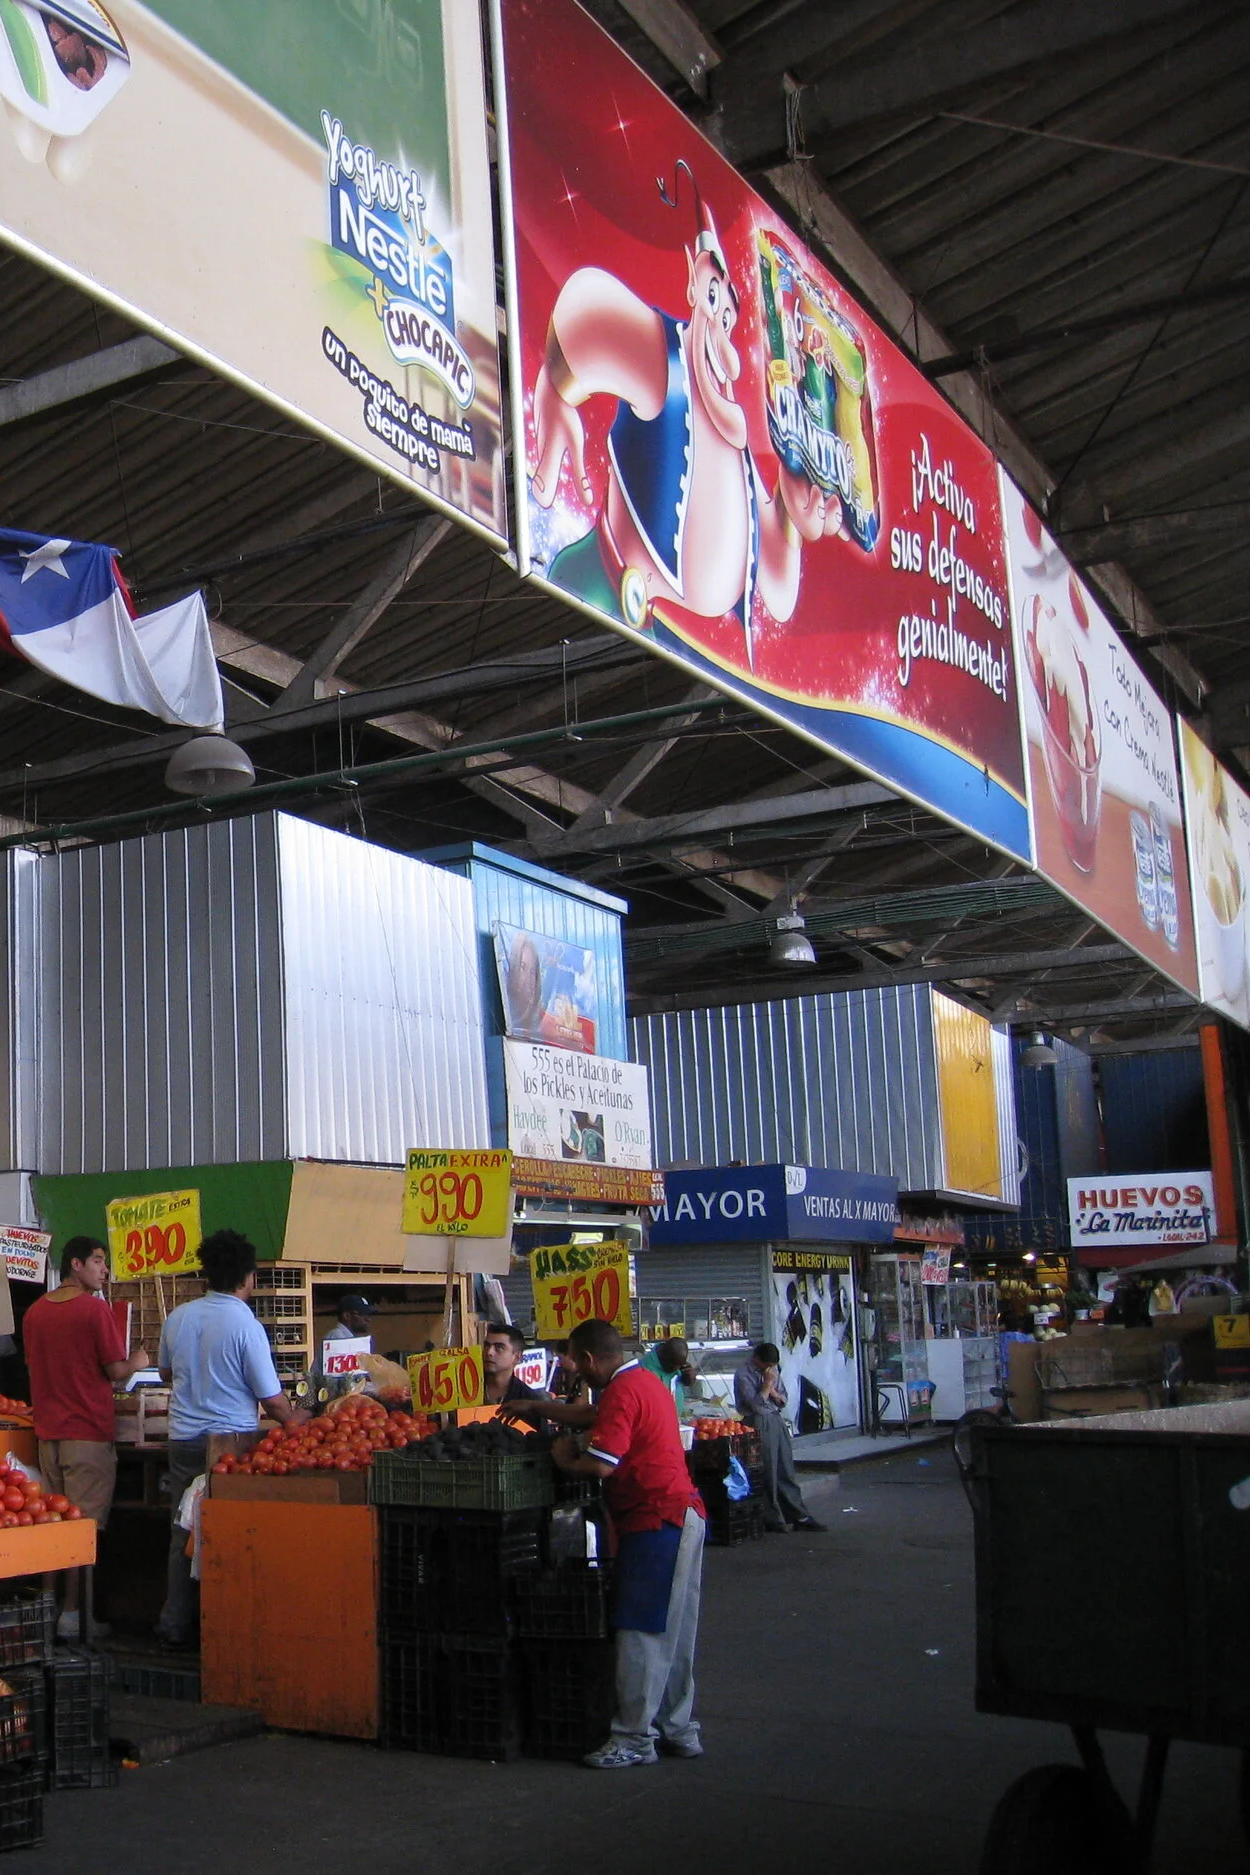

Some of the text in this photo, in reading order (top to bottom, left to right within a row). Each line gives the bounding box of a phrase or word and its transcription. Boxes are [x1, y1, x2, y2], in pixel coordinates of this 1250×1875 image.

[321, 110, 426, 244] Yoghurt
[339, 188, 447, 316] Nestlé
[324, 333, 347, 370] un
[350, 357, 408, 424] poquito
[410, 405, 428, 434] de
[386, 307, 470, 394] CHOCAPIC
[775, 385, 852, 500] CHAMYTO
[910, 432, 975, 534] ¡Activa
[890, 525, 1003, 630] sus defensas
[897, 599, 1007, 702] genialmente!
[1108, 643, 1161, 741] Todo Mejora
[1103, 699, 1122, 737] con
[1123, 716, 1149, 777] Crema
[523, 1070, 633, 1111] los Pickles y Aceitunas
[532, 1046, 623, 1086] 555 es el Palacio de
[409, 1153, 501, 1170] PALTA EXTRA
[1077, 1185, 1204, 1210] HUEVOS
[125, 1222, 187, 1273] 390
[804, 1195, 841, 1218] VENTAS
[843, 1200, 854, 1219] AL
[855, 1201, 862, 1220] X
[863, 1202, 896, 1223] MAYOR
[5, 1256, 39, 1270] UEVITOS
[549, 1268, 620, 1328] 750
[771, 1251, 794, 1267] CORE
[795, 1252, 826, 1269] ENERGY
